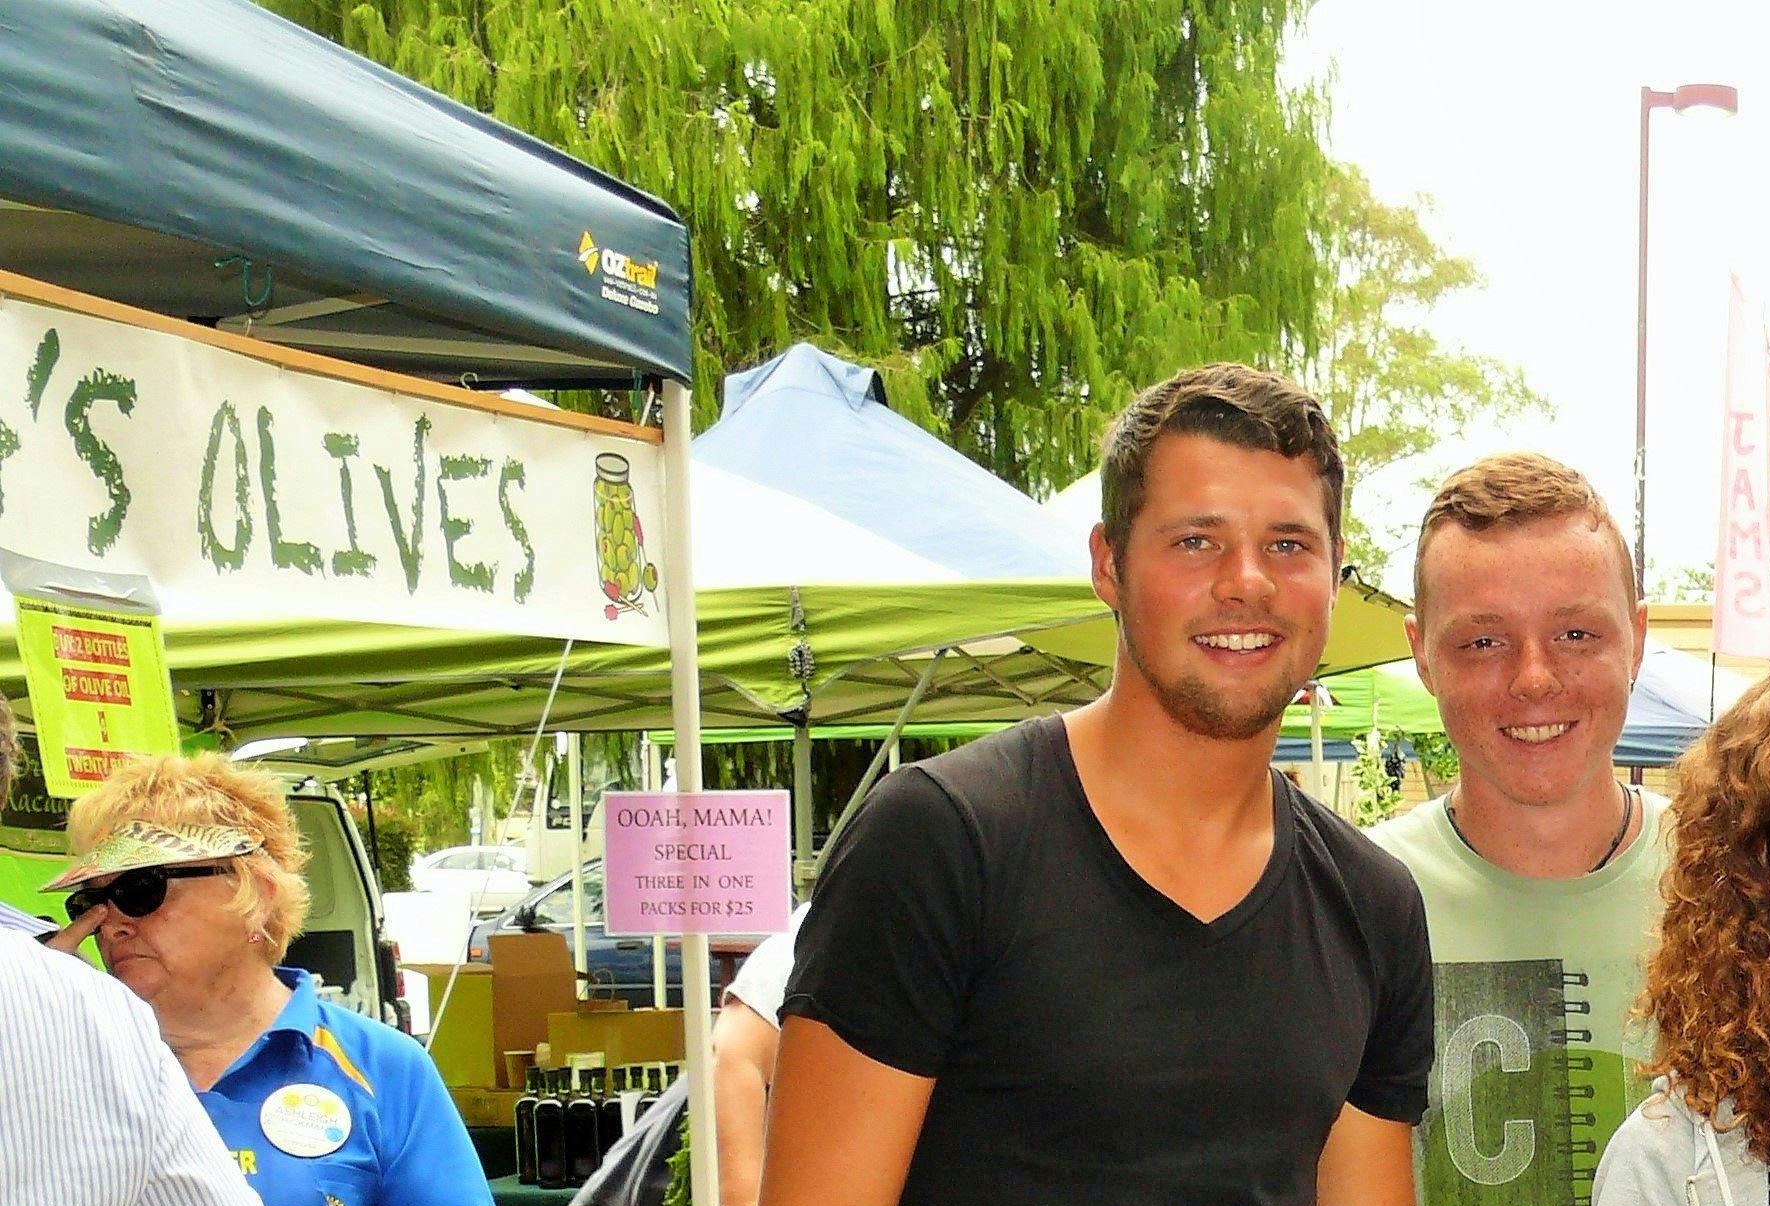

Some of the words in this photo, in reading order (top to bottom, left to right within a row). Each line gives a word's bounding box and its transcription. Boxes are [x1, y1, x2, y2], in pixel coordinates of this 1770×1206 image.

[0, 327, 137, 557] 'S
[198, 399, 535, 605] OLIVES
[84, 636, 129, 659] BOTTLES
[81, 676, 113, 696] OLIVE
[617, 808, 687, 829] OOAH,
[693, 808, 773, 827] MAMA!
[654, 844, 732, 862] SPECIAL
[635, 874, 685, 890] THREE
[693, 875, 709, 889] IN
[718, 875, 754, 889] ONE
[641, 901, 687, 916] PACKS
[690, 901, 721, 916] FOR
[726, 901, 753, 918] $25
